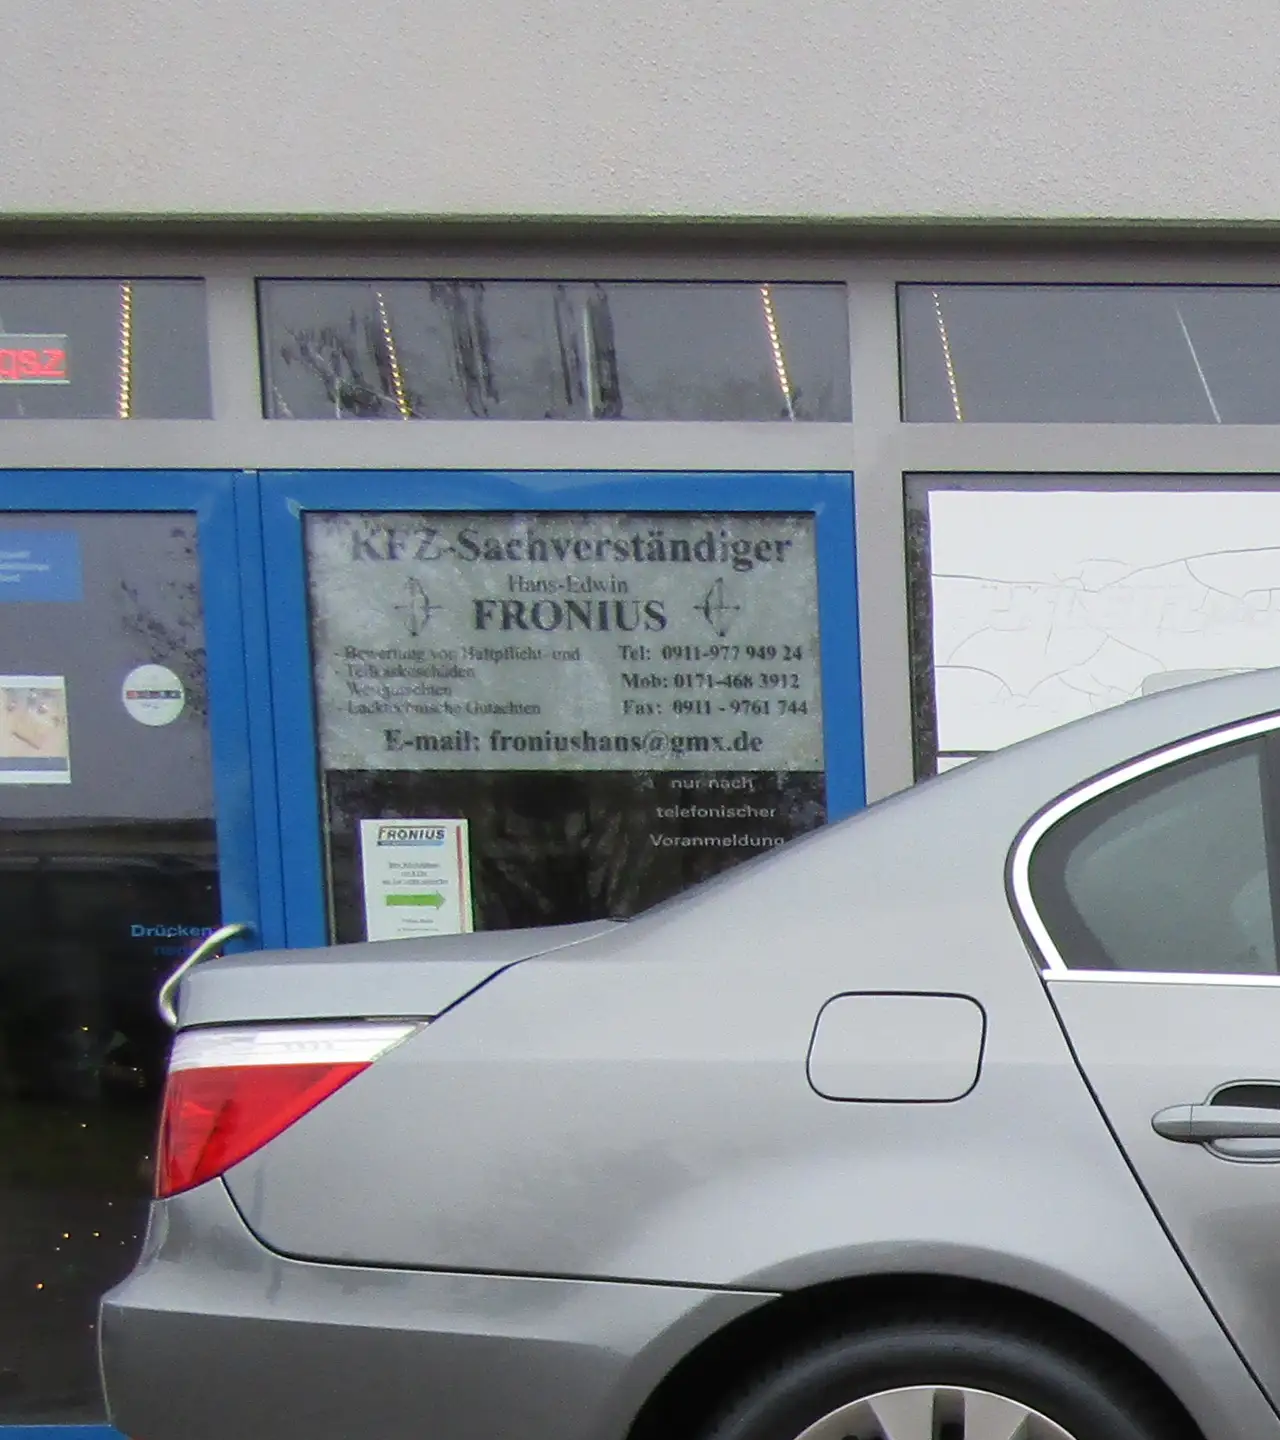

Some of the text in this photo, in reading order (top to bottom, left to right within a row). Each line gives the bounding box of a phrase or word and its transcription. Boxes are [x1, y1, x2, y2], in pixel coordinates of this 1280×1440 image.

[350, 527, 792, 572] KFZ-Sachverständiger
[508, 574, 629, 594] Hans-Edwin
[472, 599, 668, 632] FRONIUS
[552, 648, 581, 661] und
[618, 645, 803, 662] Tel: 0911-977 949 24
[621, 673, 800, 689] Mob: 0171-468 3912
[466, 701, 541, 715] Gutachten
[623, 699, 663, 715] Fax:
[672, 700, 711, 715] 0911
[730, 700, 770, 715] 9761
[779, 700, 809, 715] 744
[383, 729, 764, 758] E-mail: froniushans@gmx.de
[671, 776, 753, 790] nur nach
[656, 804, 777, 818] telefonischer
[378, 826, 445, 840] FRONIUS
[650, 833, 785, 848] Voranmeldung
[130, 923, 213, 938] Drücken
